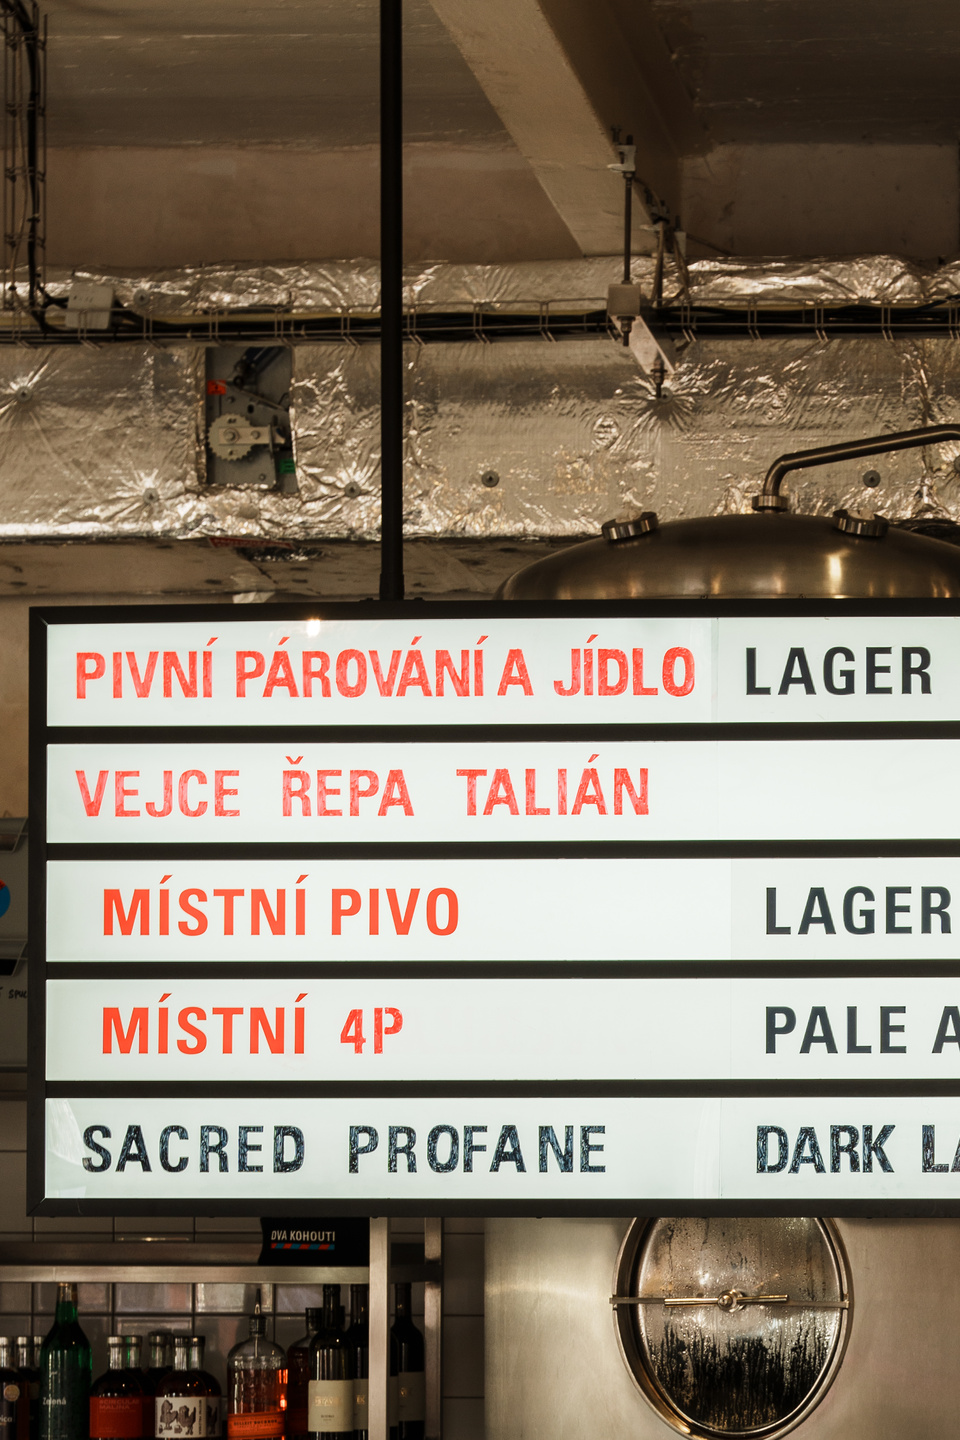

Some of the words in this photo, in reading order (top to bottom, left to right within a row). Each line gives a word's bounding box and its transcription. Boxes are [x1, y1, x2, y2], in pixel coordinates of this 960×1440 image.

[77, 637, 218, 699] PIVNÍ
[236, 636, 488, 698] PÁROVÁNÍ
[497, 649, 534, 696] A
[554, 634, 694, 697] JÍDLO
[746, 647, 932, 695] LAGER
[75, 770, 240, 817] VEJCE
[283, 756, 414, 816] ŘEPA
[456, 754, 649, 816] TALIÁN
[104, 875, 308, 936] MÍSTNÍ
[332, 888, 458, 936] PIVO
[766, 886, 951, 935] LAGER
[103, 993, 308, 1055] MÍSTNÍ
[341, 1007, 403, 1054] 4P
[766, 1006, 906, 1054] PALE
[82, 1125, 304, 1173] SACRED
[349, 1125, 605, 1173] PROFANE
[756, 1125, 895, 1174] DARK
[271, 1230, 287, 1240] DVA
[290, 1230, 335, 1241] KOHOUTI
